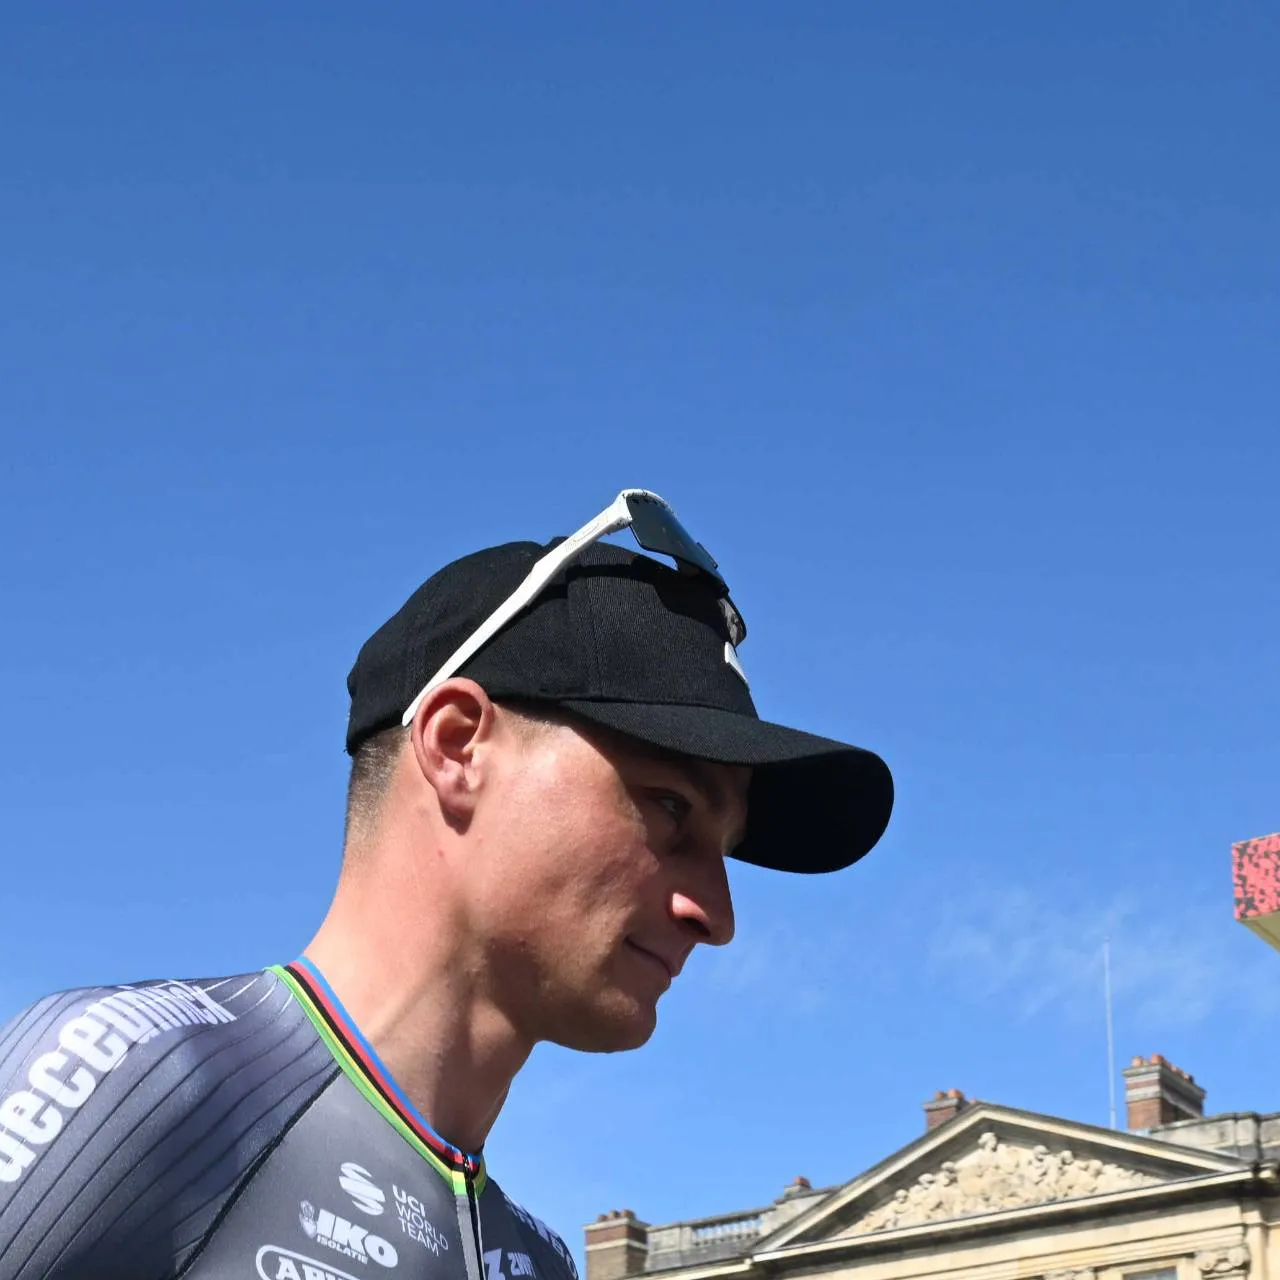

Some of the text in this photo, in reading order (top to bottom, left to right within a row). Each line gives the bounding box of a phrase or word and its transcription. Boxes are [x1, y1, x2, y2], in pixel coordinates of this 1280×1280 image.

[392, 1183, 426, 1218] UCI
[316, 1207, 400, 1268] IKO
[395, 1200, 449, 1251] WORLD
[398, 1216, 440, 1256] TEAM
